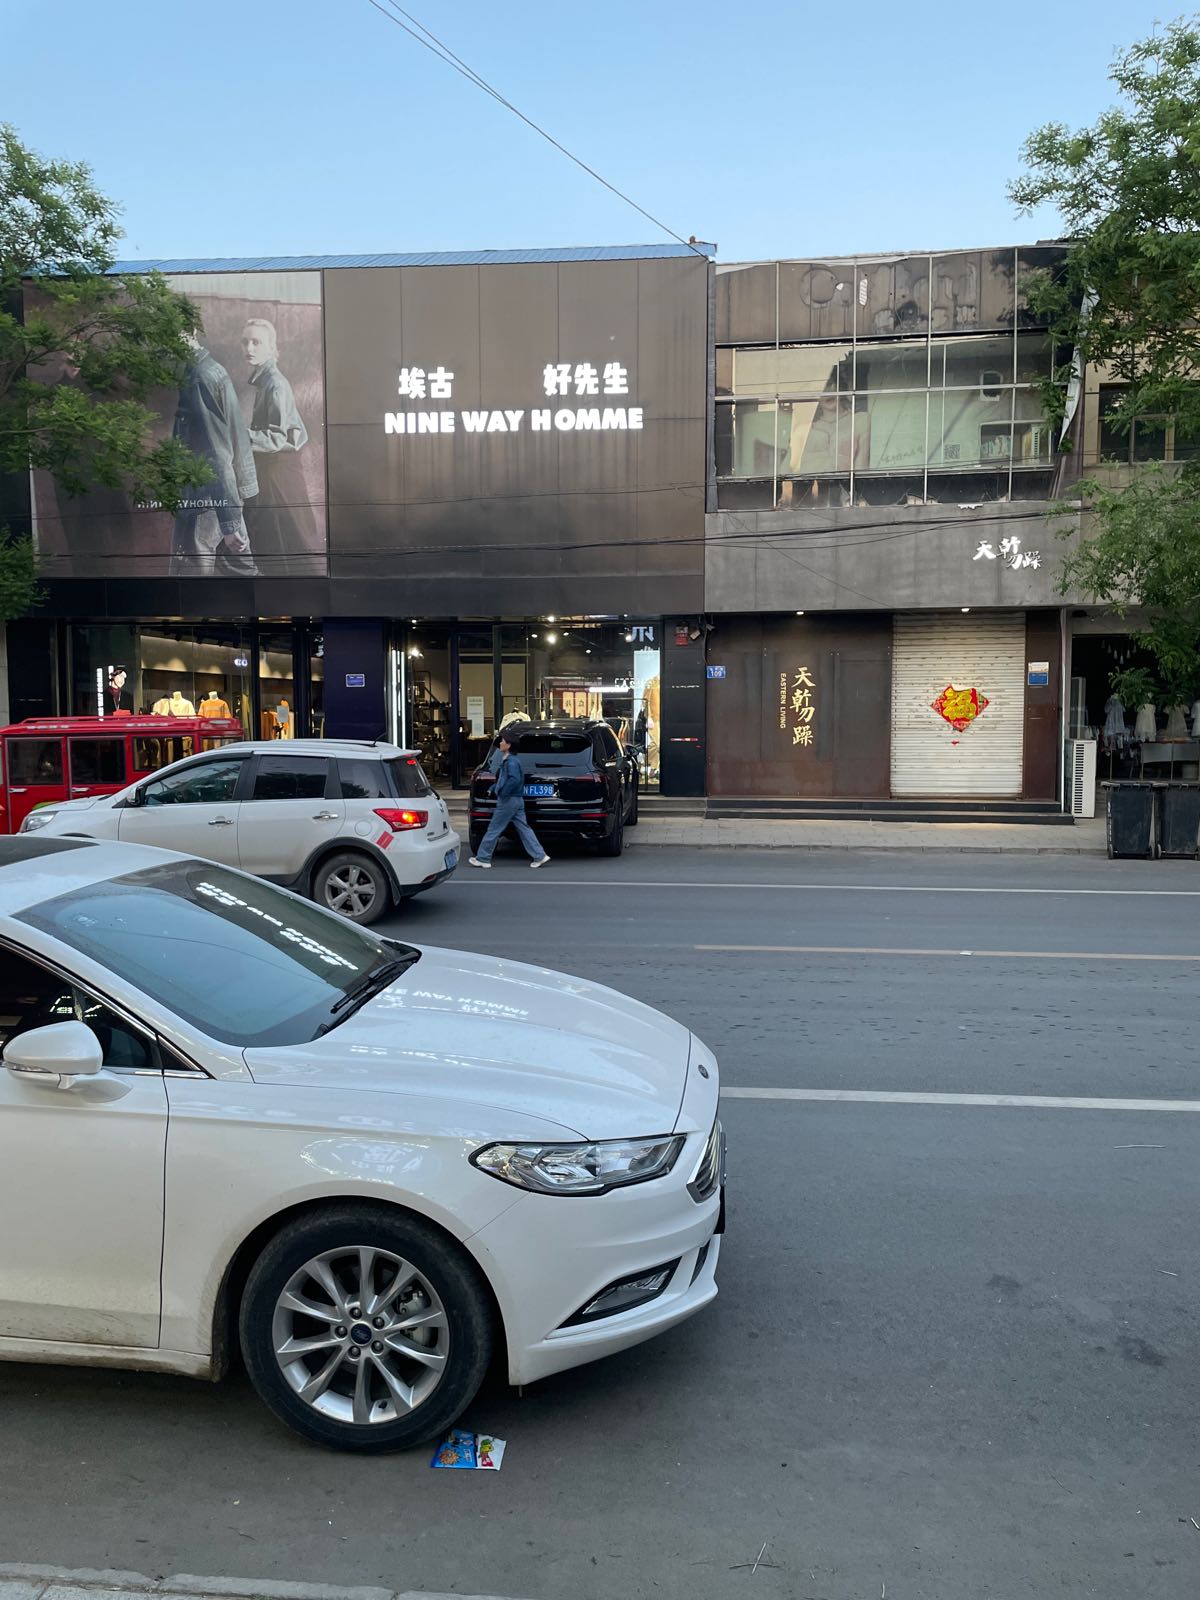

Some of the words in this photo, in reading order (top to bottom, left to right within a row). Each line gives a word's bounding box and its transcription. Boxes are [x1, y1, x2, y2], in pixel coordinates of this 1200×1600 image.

[398, 366, 454, 399] 埃古
[543, 362, 629, 396] 好先生
[384, 412, 456, 434] NINE
[461, 410, 525, 432] WAY
[531, 407, 644, 431] HOMME
[779, 672, 787, 705] EASTERN
[779, 706, 787, 729] LIVING
